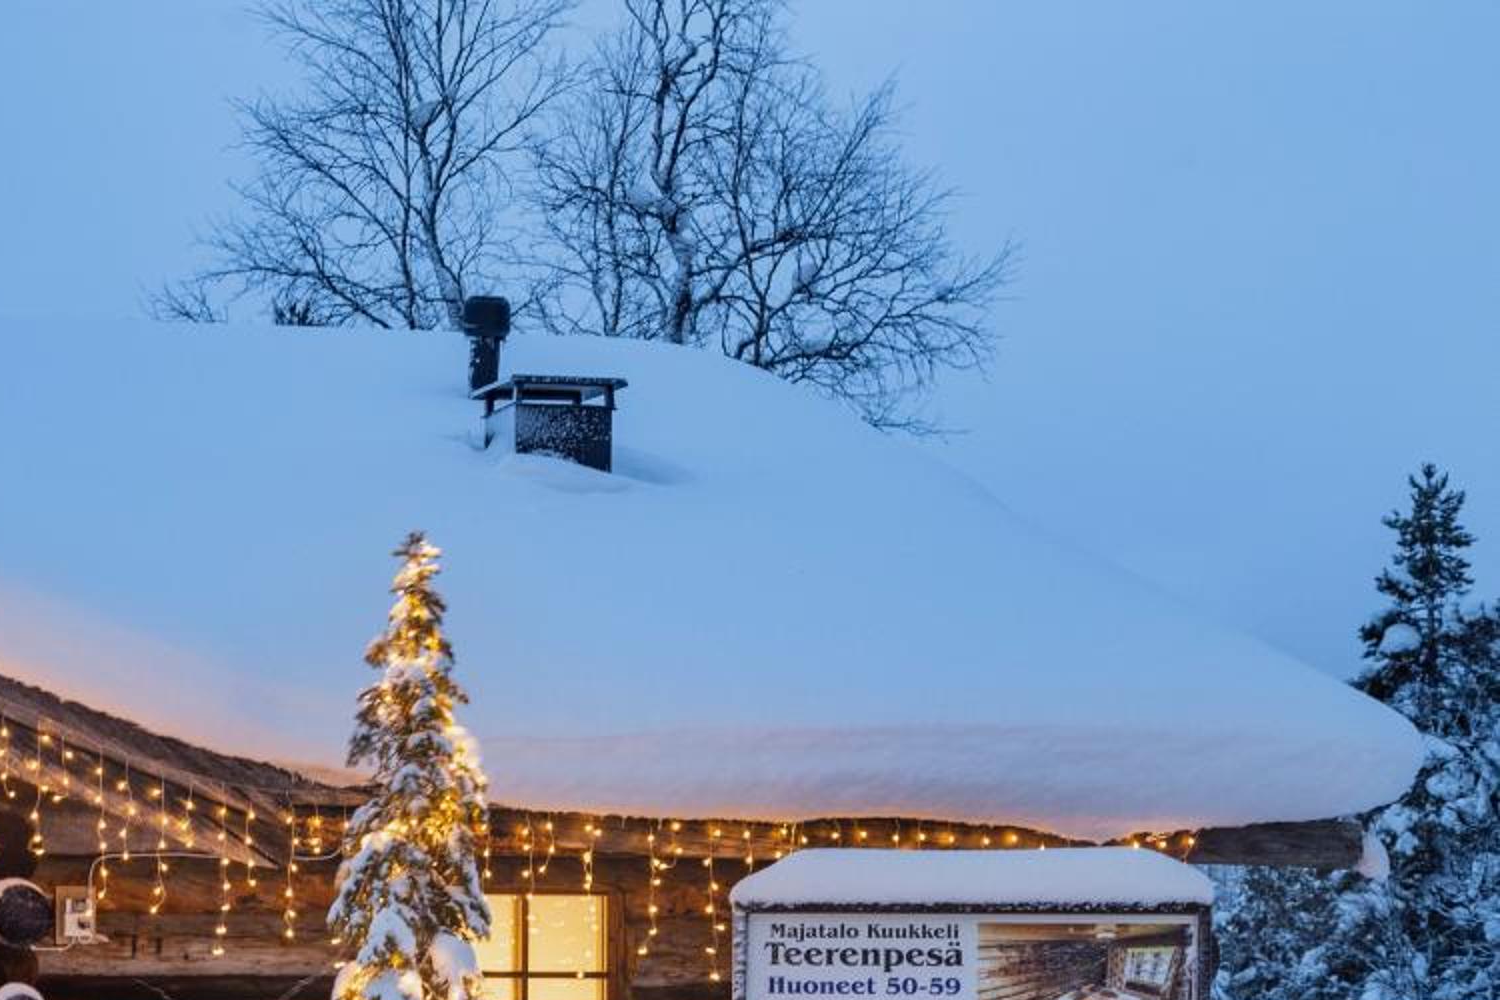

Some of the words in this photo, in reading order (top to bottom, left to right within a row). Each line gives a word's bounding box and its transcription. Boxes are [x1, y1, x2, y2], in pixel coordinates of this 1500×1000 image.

[770, 922, 859, 942] Majatalo
[867, 922, 960, 939] Kuukkeli
[764, 941, 964, 972] Teerenpesä
[768, 975, 877, 995] Huoneet
[886, 976, 961, 995] 50-59
